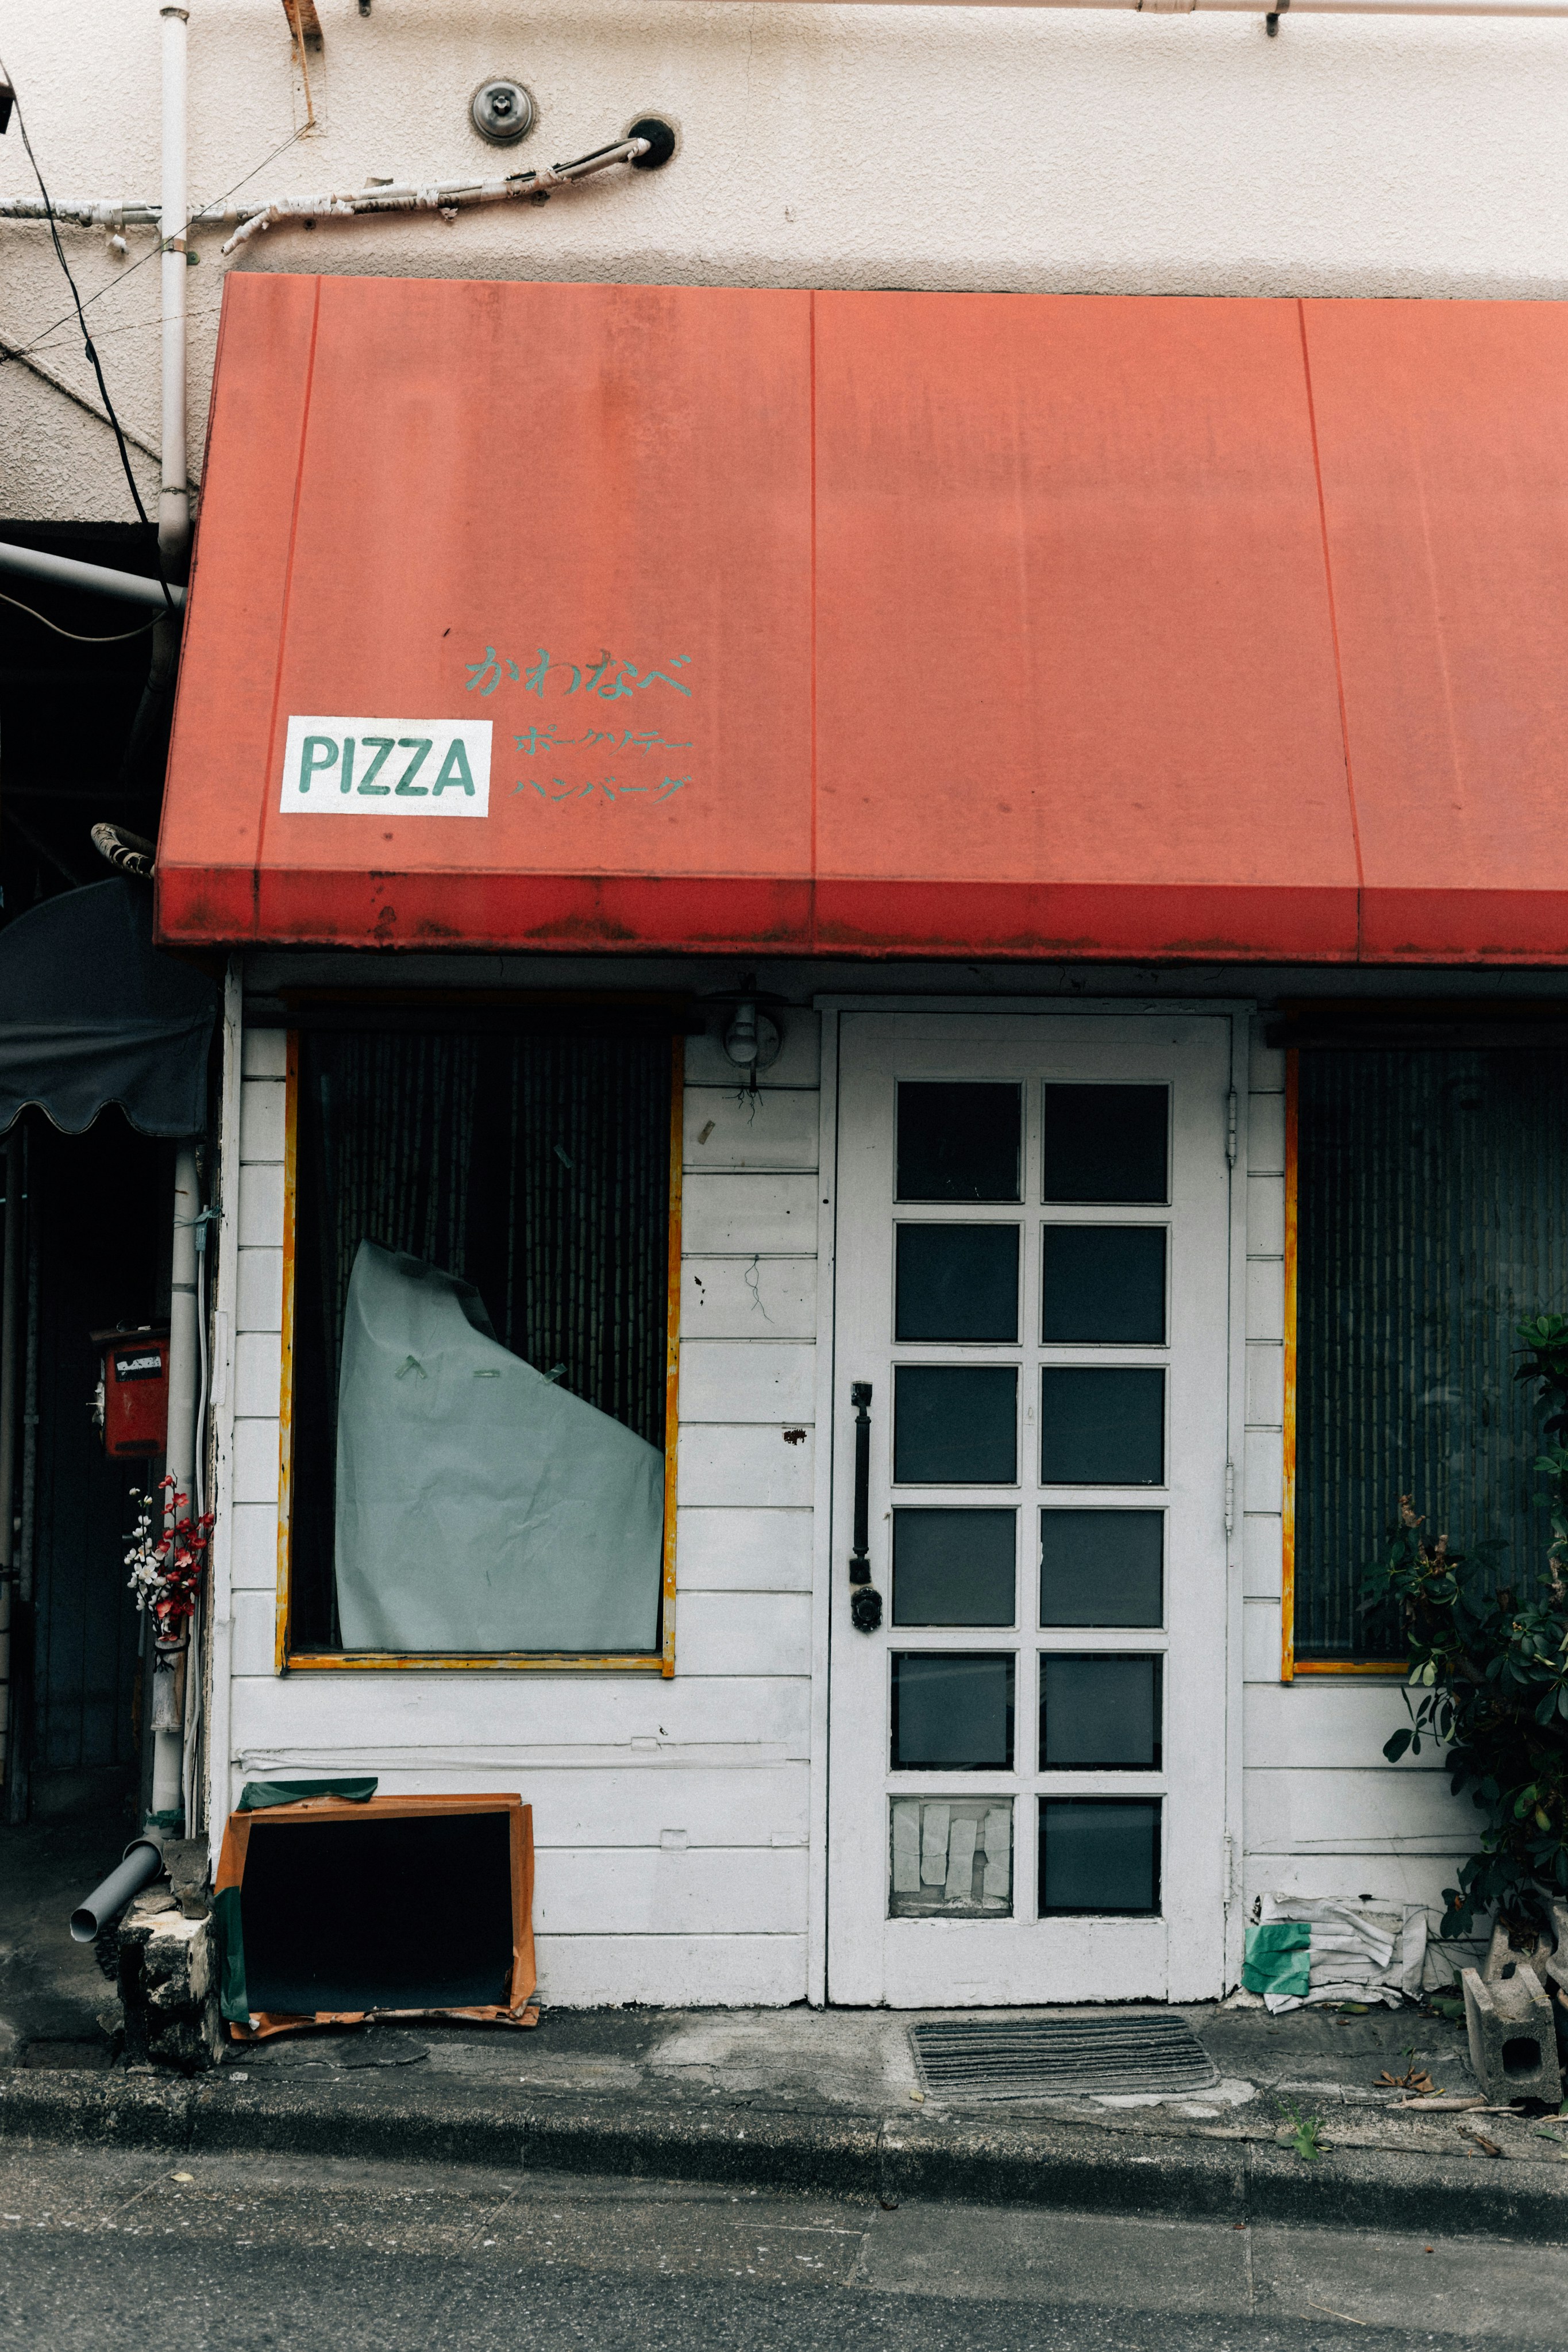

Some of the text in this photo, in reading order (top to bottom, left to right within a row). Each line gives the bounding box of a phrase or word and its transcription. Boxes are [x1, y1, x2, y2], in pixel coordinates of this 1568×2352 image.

[465, 646, 693, 701] かわなべ
[513, 724, 694, 757] ポークソテー
[299, 736, 476, 796] PIZZA
[508, 775, 693, 804] ハンバーグ
